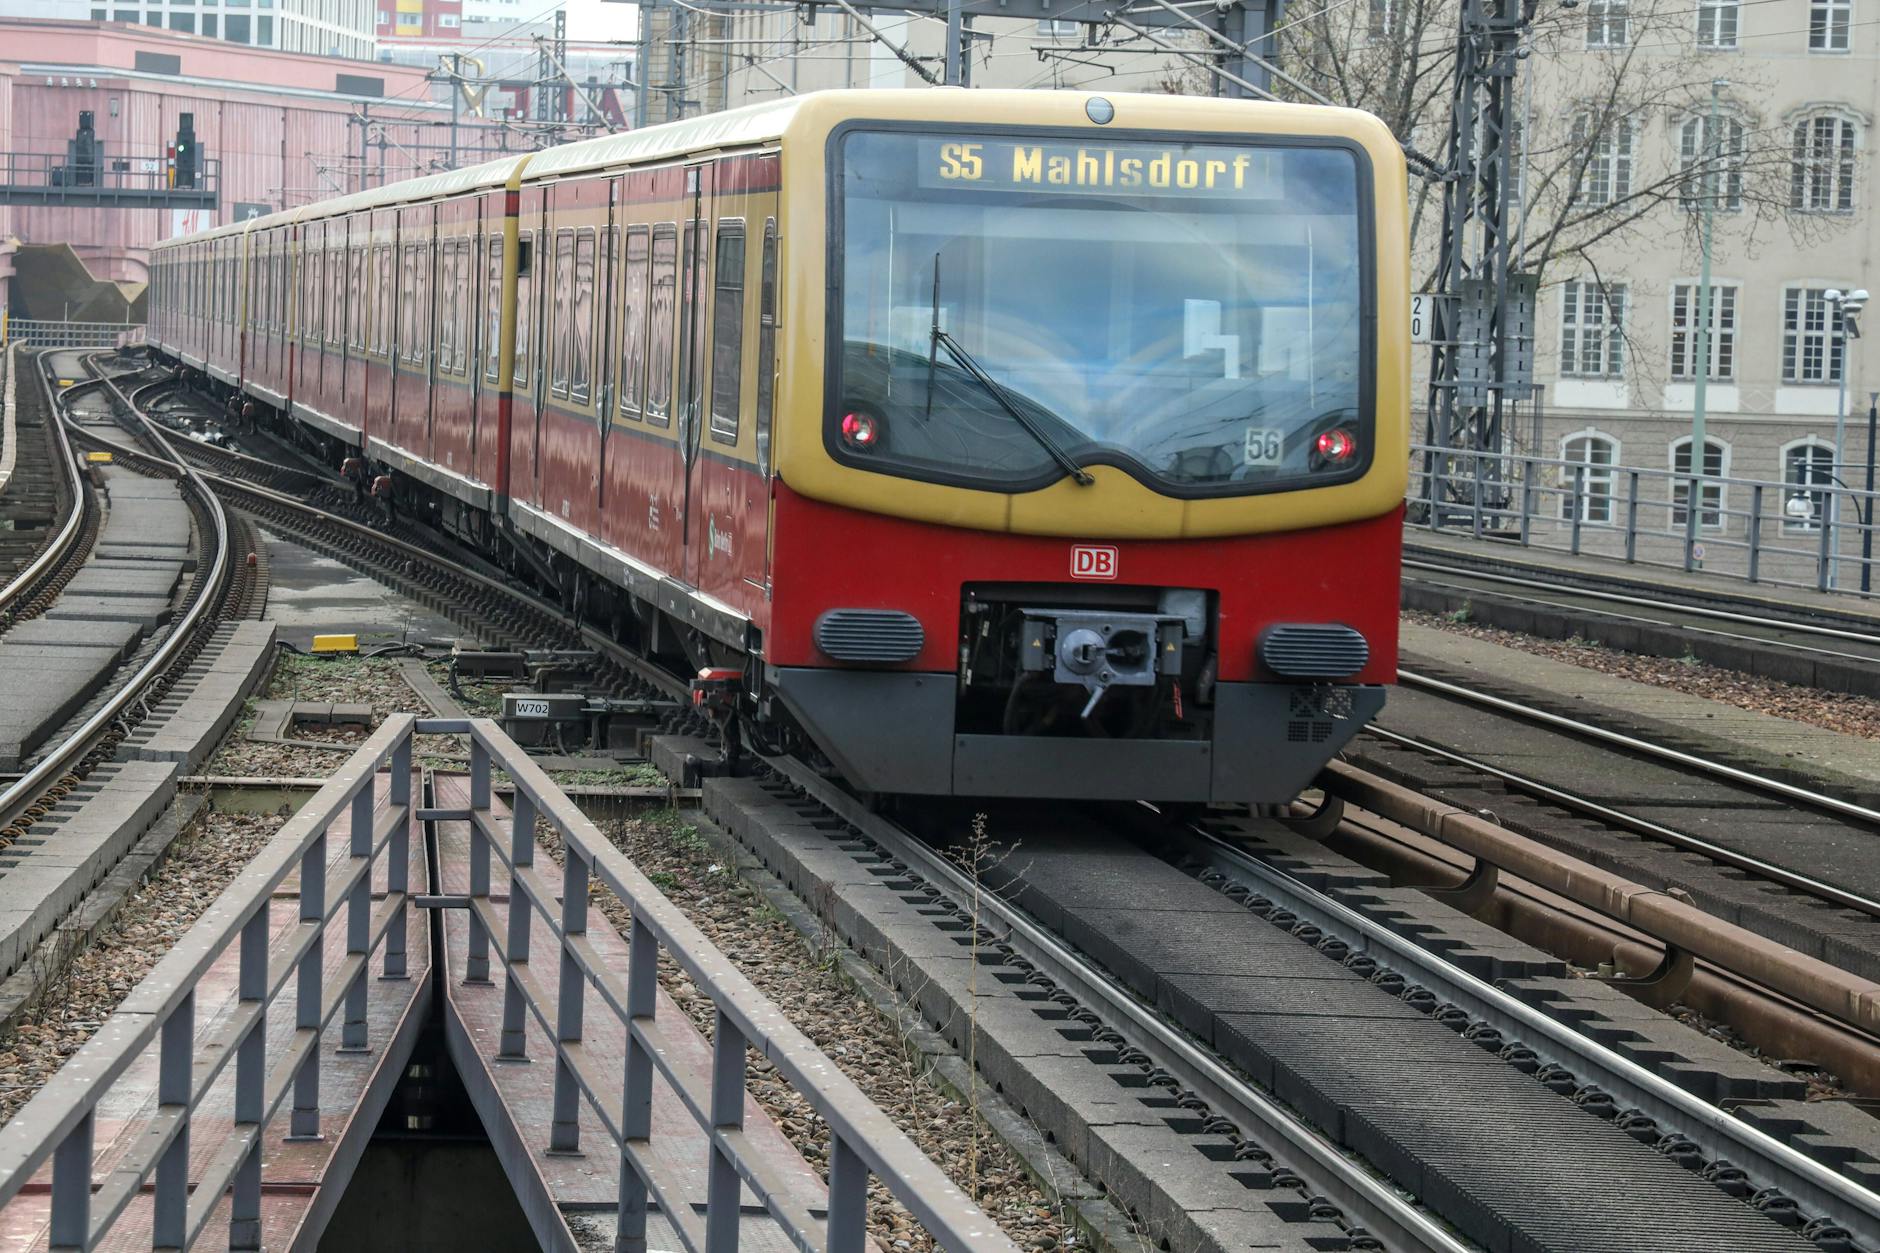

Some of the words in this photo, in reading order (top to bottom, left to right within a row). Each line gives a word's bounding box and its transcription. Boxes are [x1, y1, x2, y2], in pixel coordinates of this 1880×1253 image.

[940, 143, 983, 180] S5
[1013, 146, 1251, 190] Mahlsdorf
[1247, 430, 1280, 461] 56
[1077, 550, 1112, 573] DB
[517, 703, 549, 714] W702
